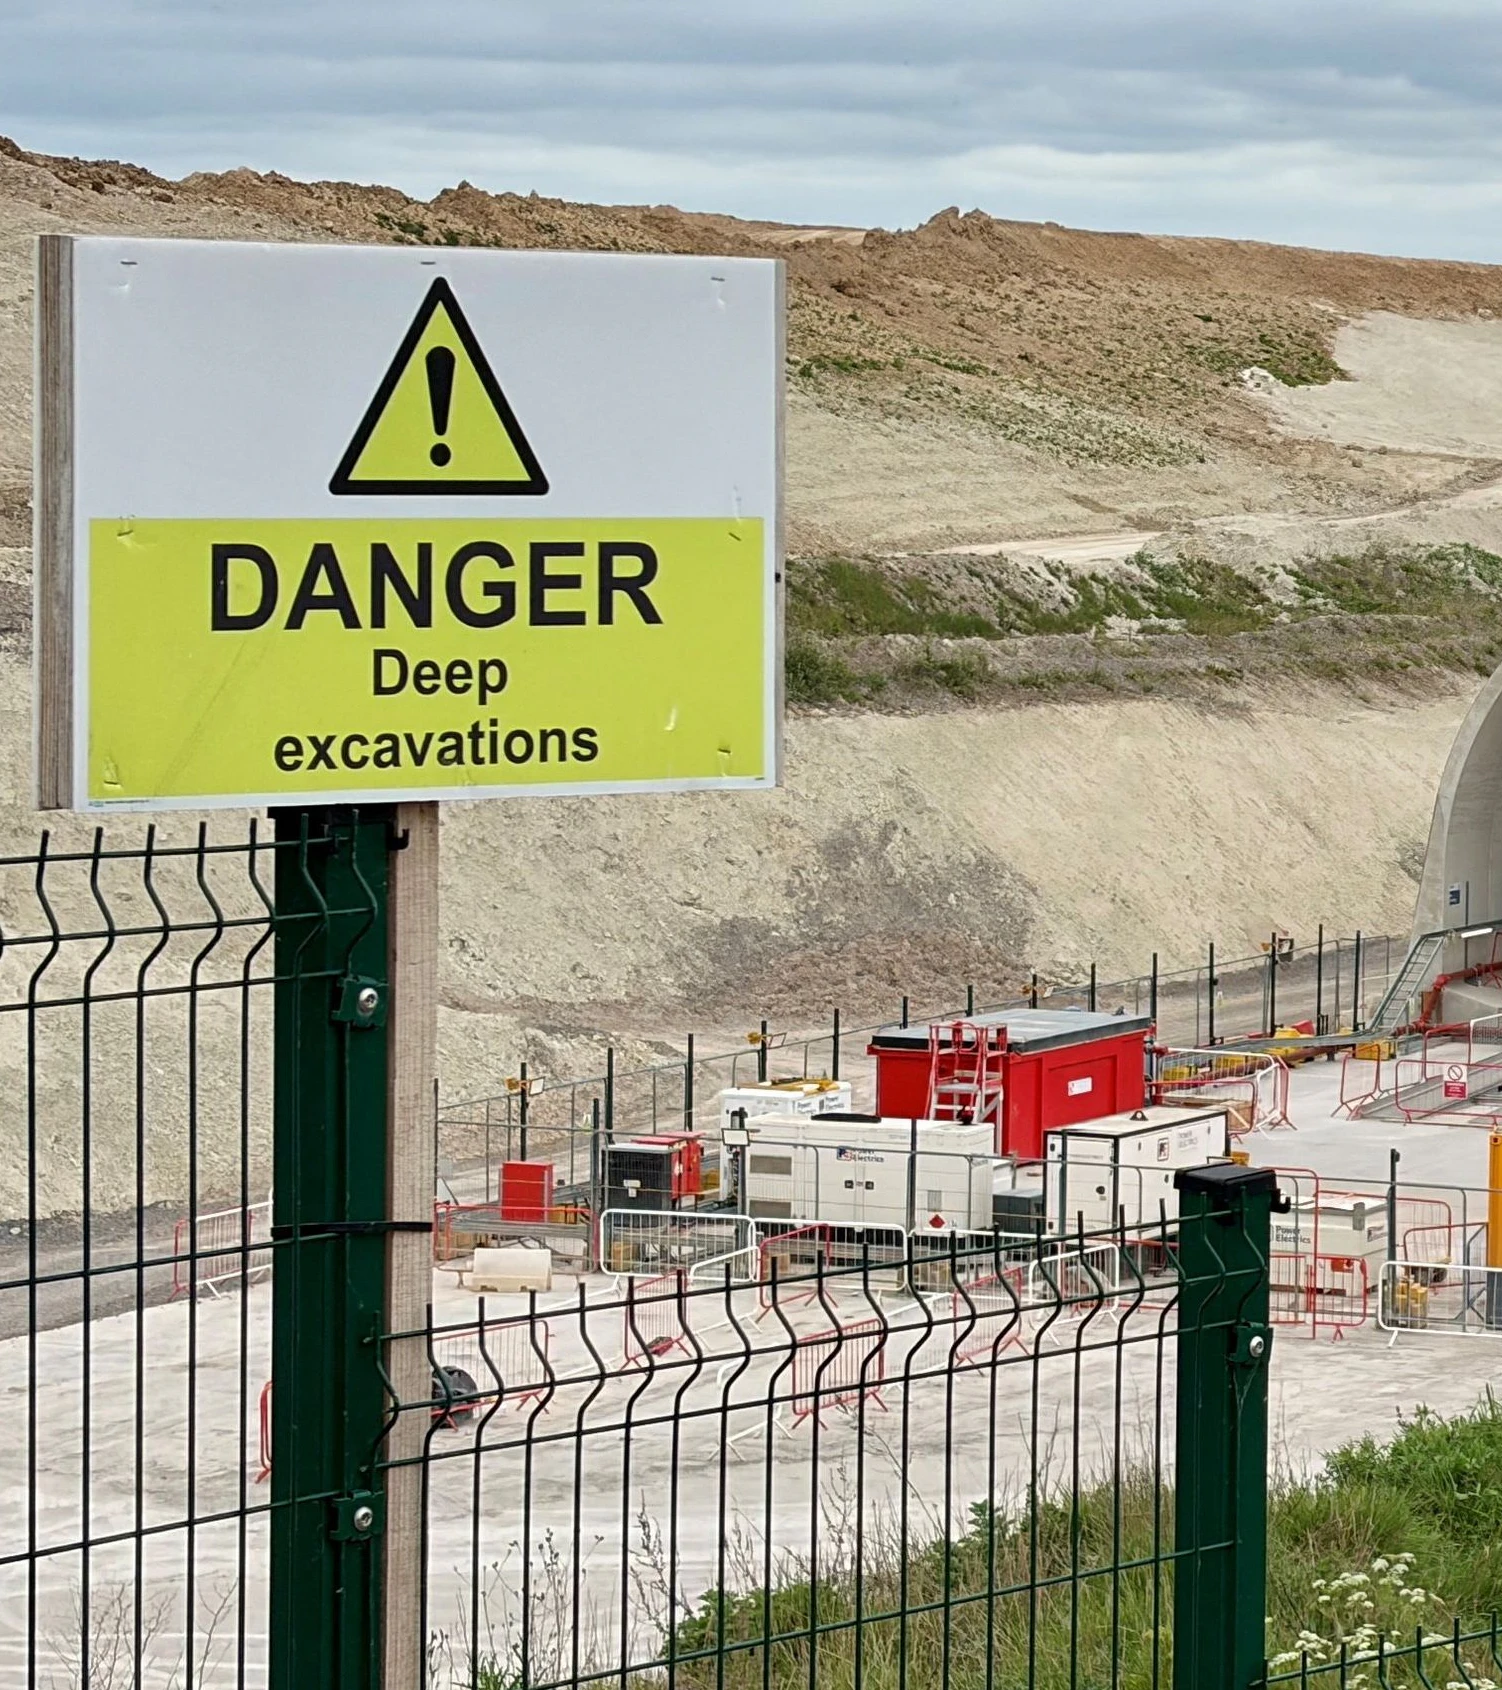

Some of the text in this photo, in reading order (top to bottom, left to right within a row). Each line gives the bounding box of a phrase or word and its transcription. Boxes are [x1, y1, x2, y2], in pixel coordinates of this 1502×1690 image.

[211, 541, 663, 632] DANGER
[373, 648, 509, 706] Deep
[274, 720, 600, 772] excavations
[1276, 1225, 1300, 1234] Power
[1276, 1234, 1311, 1244] Electrics
